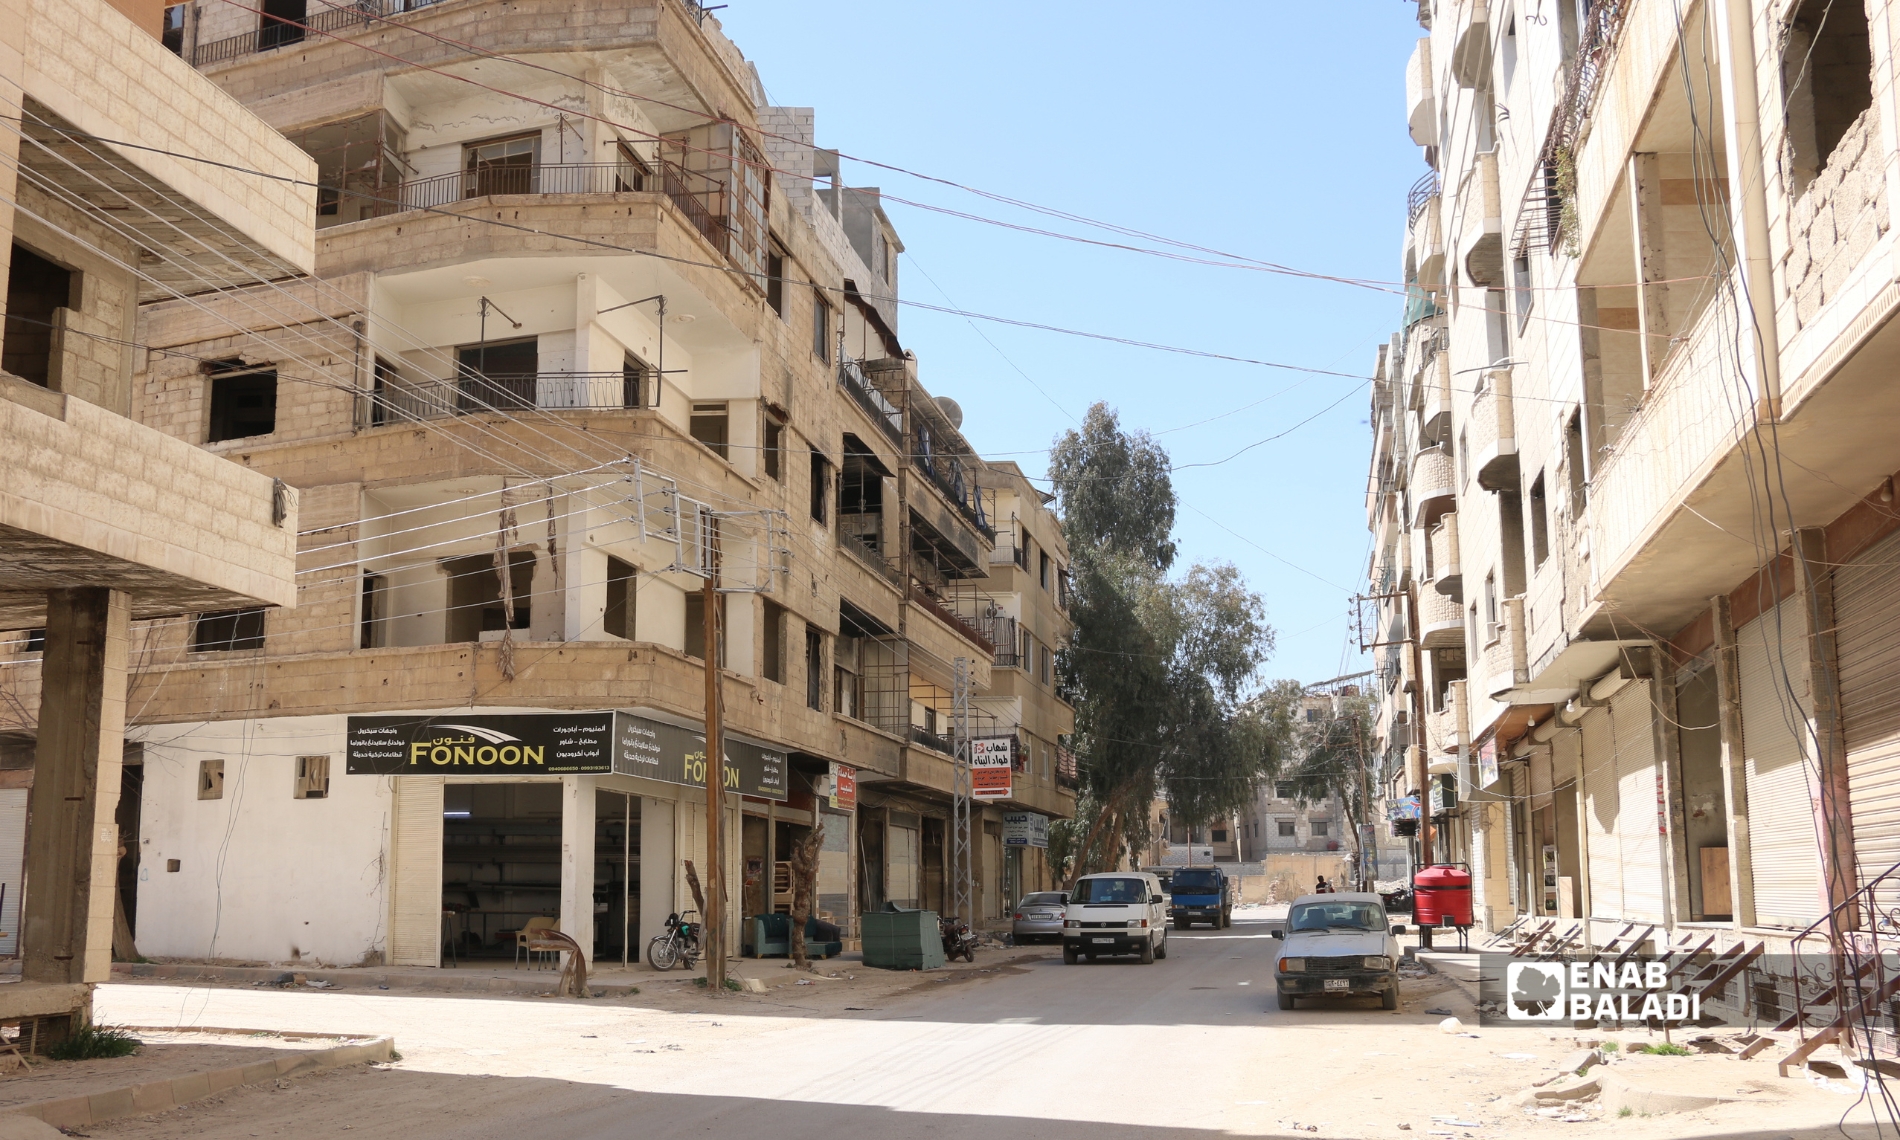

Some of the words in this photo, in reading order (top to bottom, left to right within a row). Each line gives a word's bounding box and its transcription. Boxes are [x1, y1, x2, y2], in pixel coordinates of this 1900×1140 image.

[432, 734, 476, 746] فنون
[410, 742, 545, 766] FONOON
[986, 742, 1008, 754] شهاب
[974, 755, 990, 767] البناء
